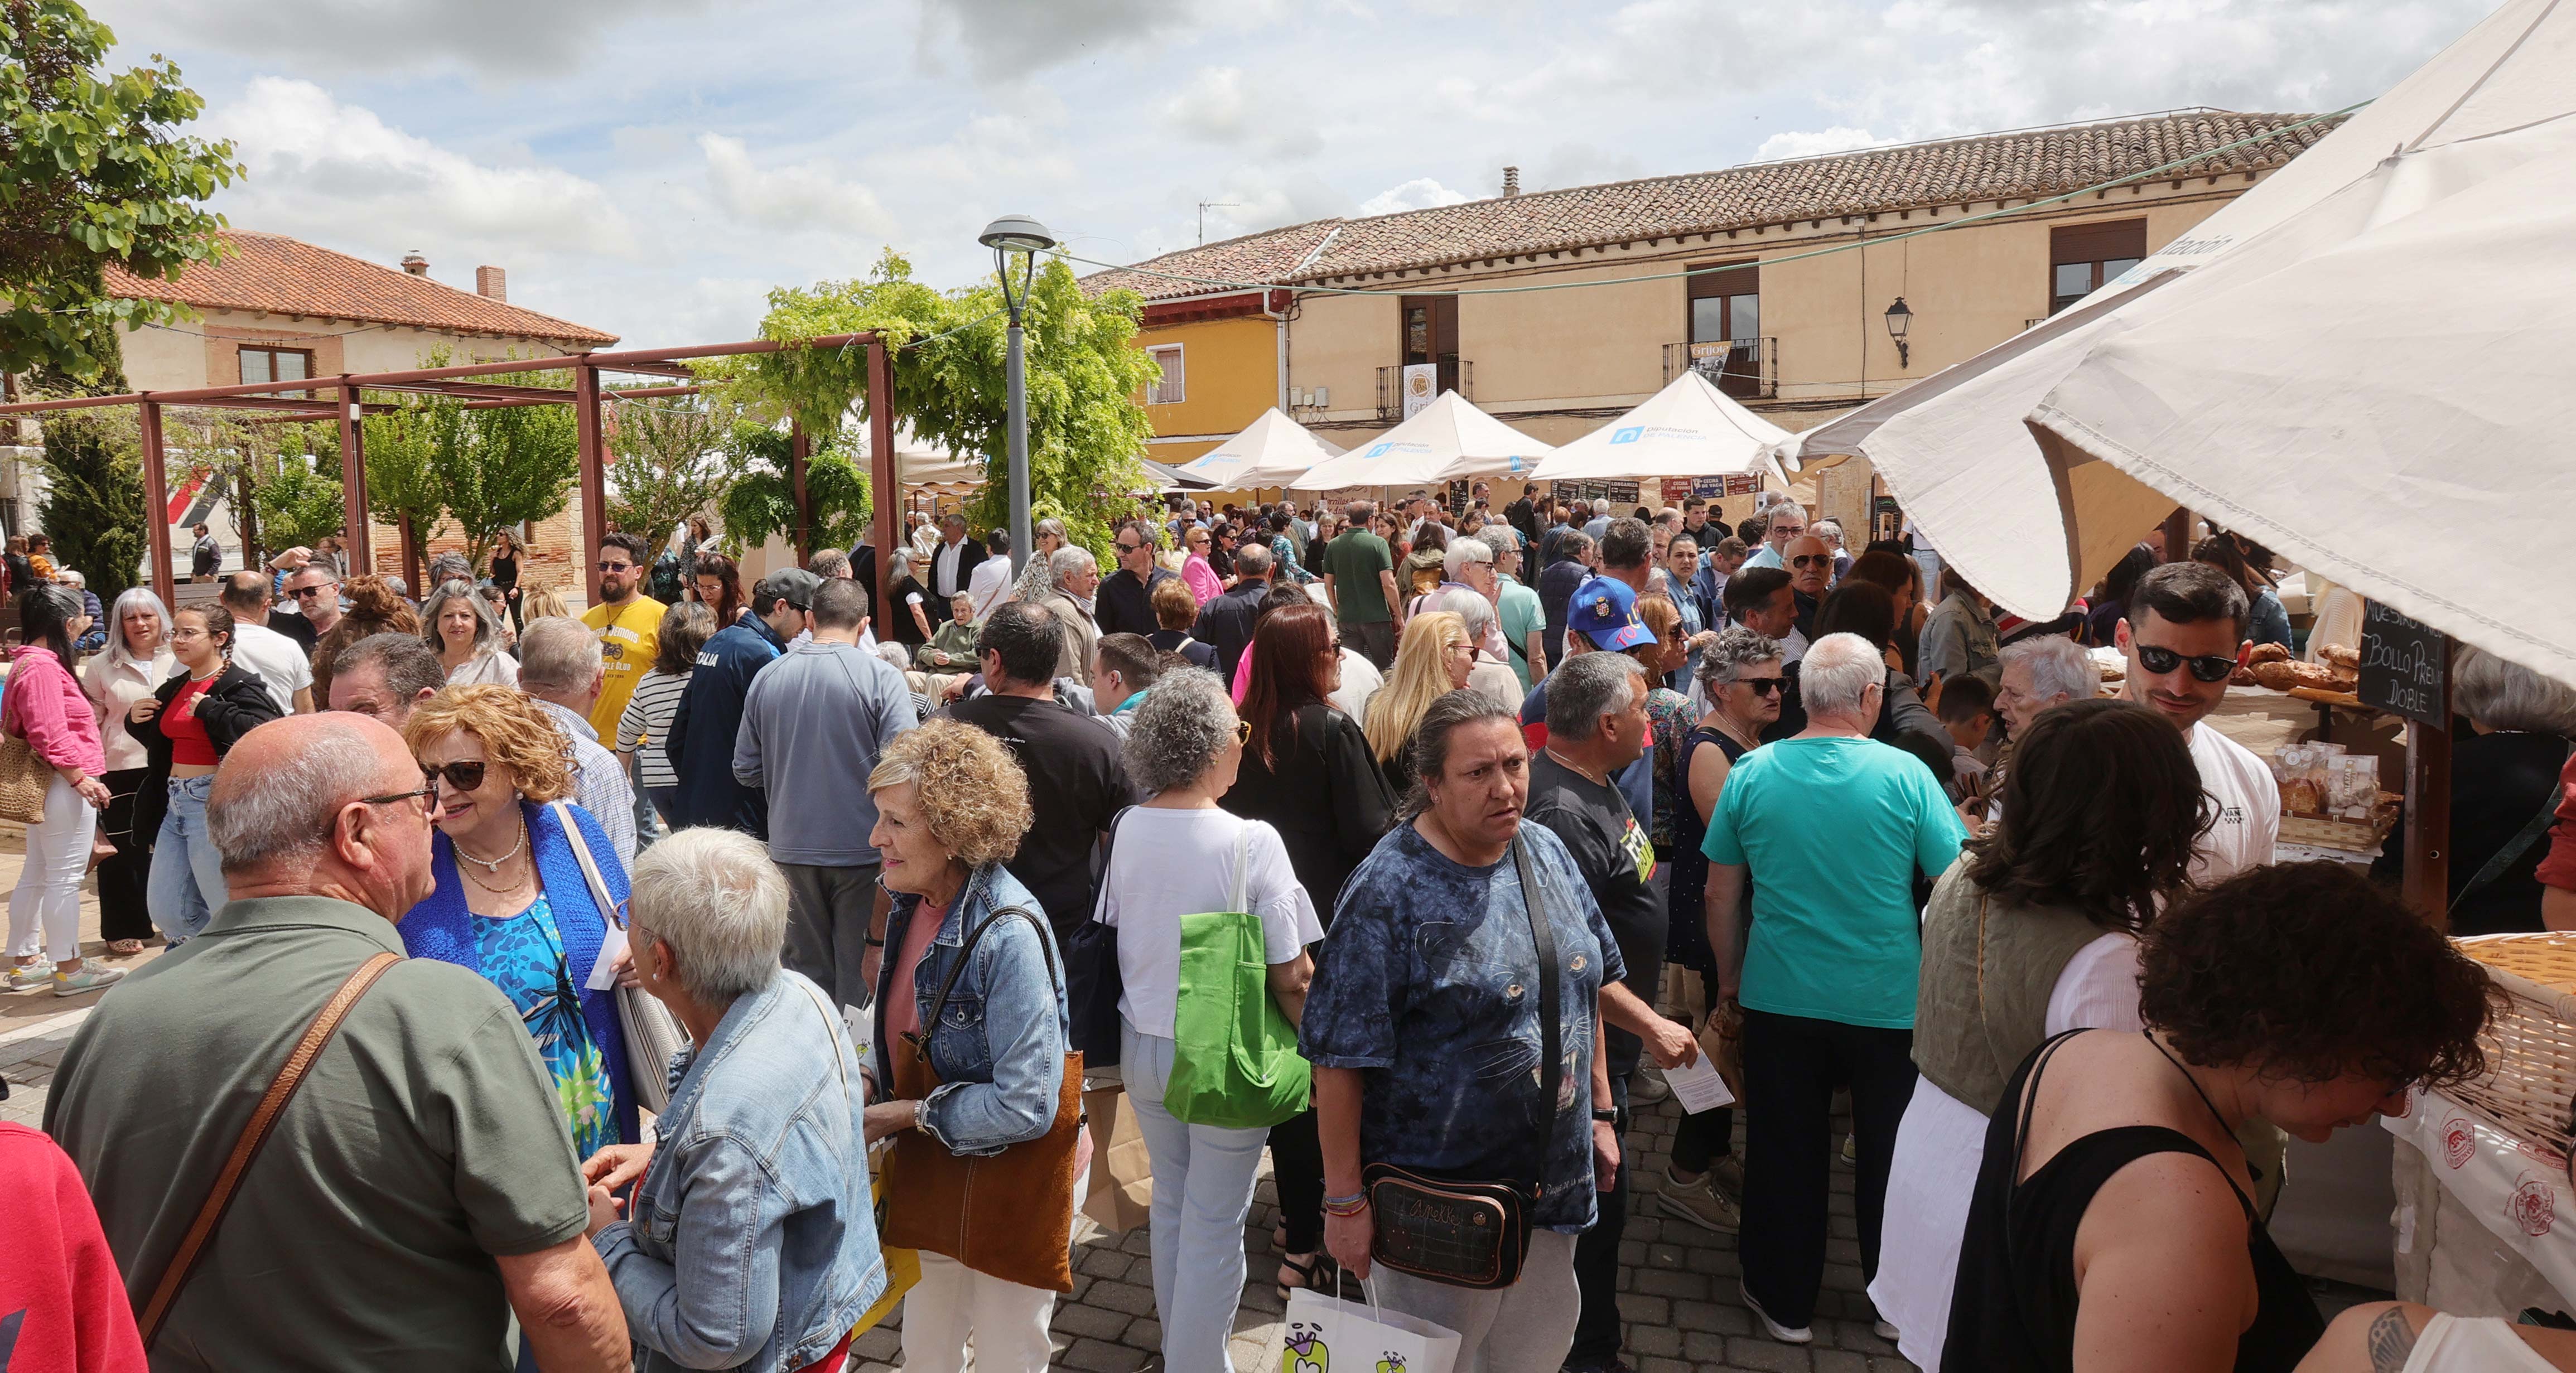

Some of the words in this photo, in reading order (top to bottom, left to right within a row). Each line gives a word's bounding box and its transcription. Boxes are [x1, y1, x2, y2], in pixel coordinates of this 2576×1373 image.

[1692, 345, 1729, 356] Grijota
[696, 651, 719, 668] TALIA
[2361, 633, 2411, 674] BOLLO
[615, 661, 631, 671] CLUB
[2386, 679, 2428, 713] DOBLE
[2221, 806, 2242, 817] VAN
